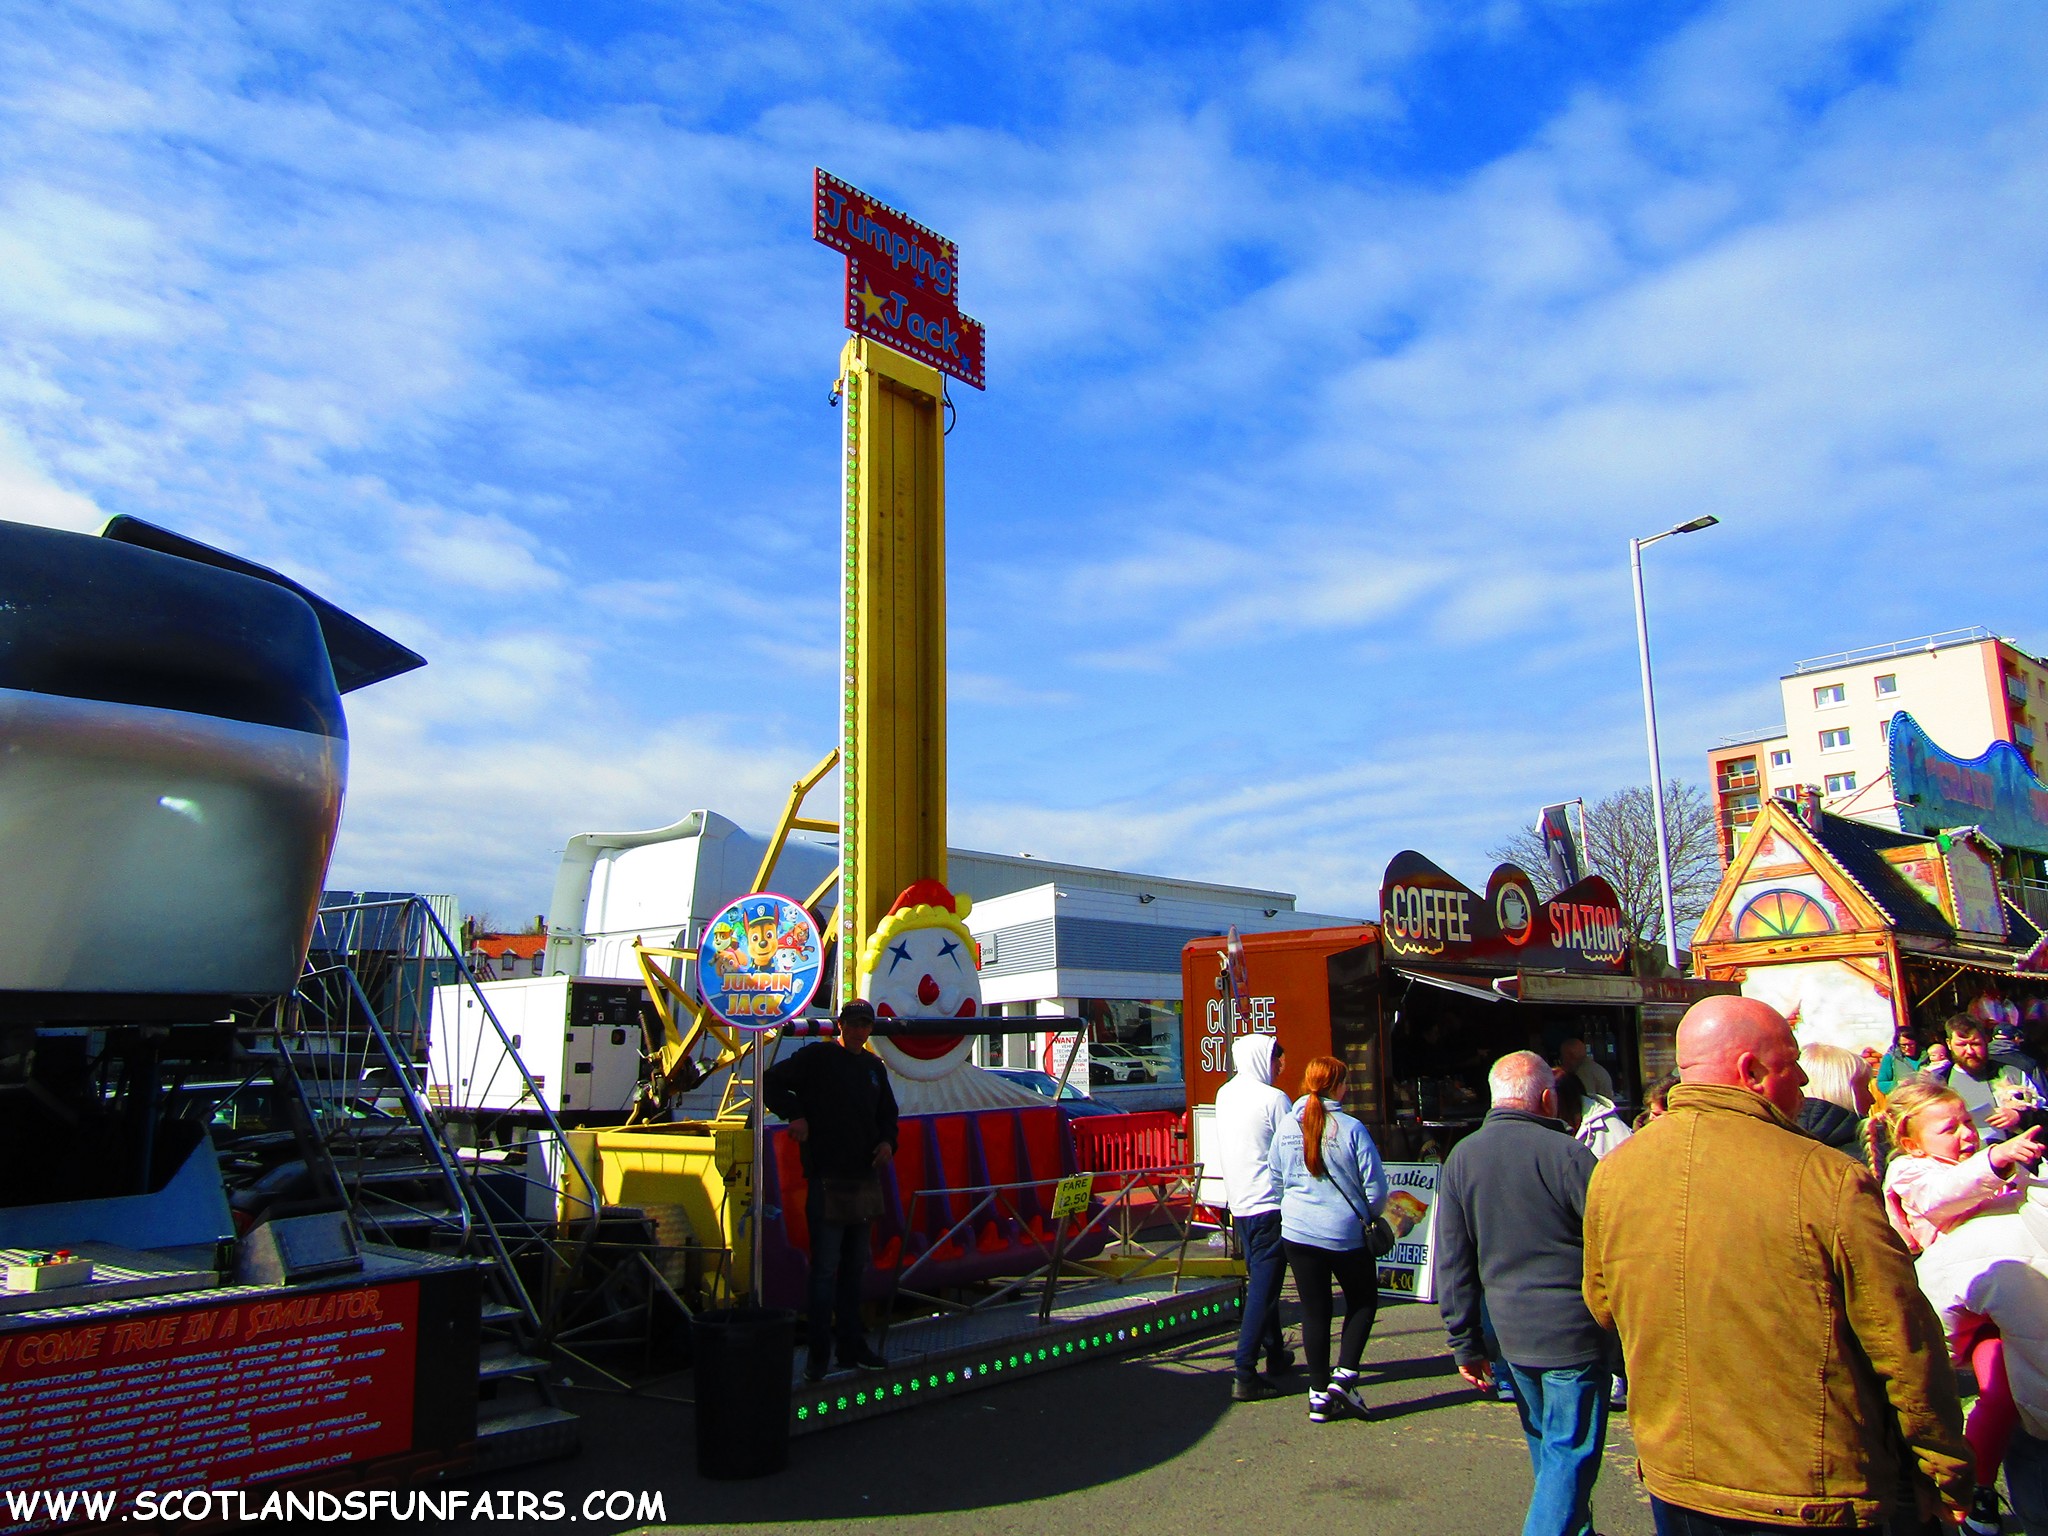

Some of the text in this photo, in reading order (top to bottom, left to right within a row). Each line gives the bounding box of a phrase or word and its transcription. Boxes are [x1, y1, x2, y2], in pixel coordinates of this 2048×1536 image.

[823, 189, 952, 297] Jumping
[884, 290, 960, 358] Jack
[1392, 884, 1621, 952] COFFEE STATION
[721, 972, 794, 993] JUMPIN
[725, 993, 786, 1017] JACK
[1054, 1036, 1087, 1044] WANTD
[1062, 1178, 1089, 1192] FARE
[1385, 1169, 1434, 1190] oasties
[1398, 1243, 1429, 1265] HERE
[17, 1326, 108, 1368] COME
[111, 1316, 182, 1356] TRUE
[182, 1311, 219, 1345] IN
[218, 1308, 239, 1340] A
[244, 1289, 384, 1342] SIMULATOR,
[12, 1370, 97, 1390] SOPHISTICATED
[101, 1359, 168, 1376] TECHNOLOGY
[219, 1386, 240, 1396] YOU
[242, 1382, 257, 1392] TO
[30, 1398, 88, 1415] POWERFUL
[93, 1389, 143, 1405] ILLUSION
[19, 1433, 45, 1445] CAN
[260, 1391, 282, 1401] CAN
